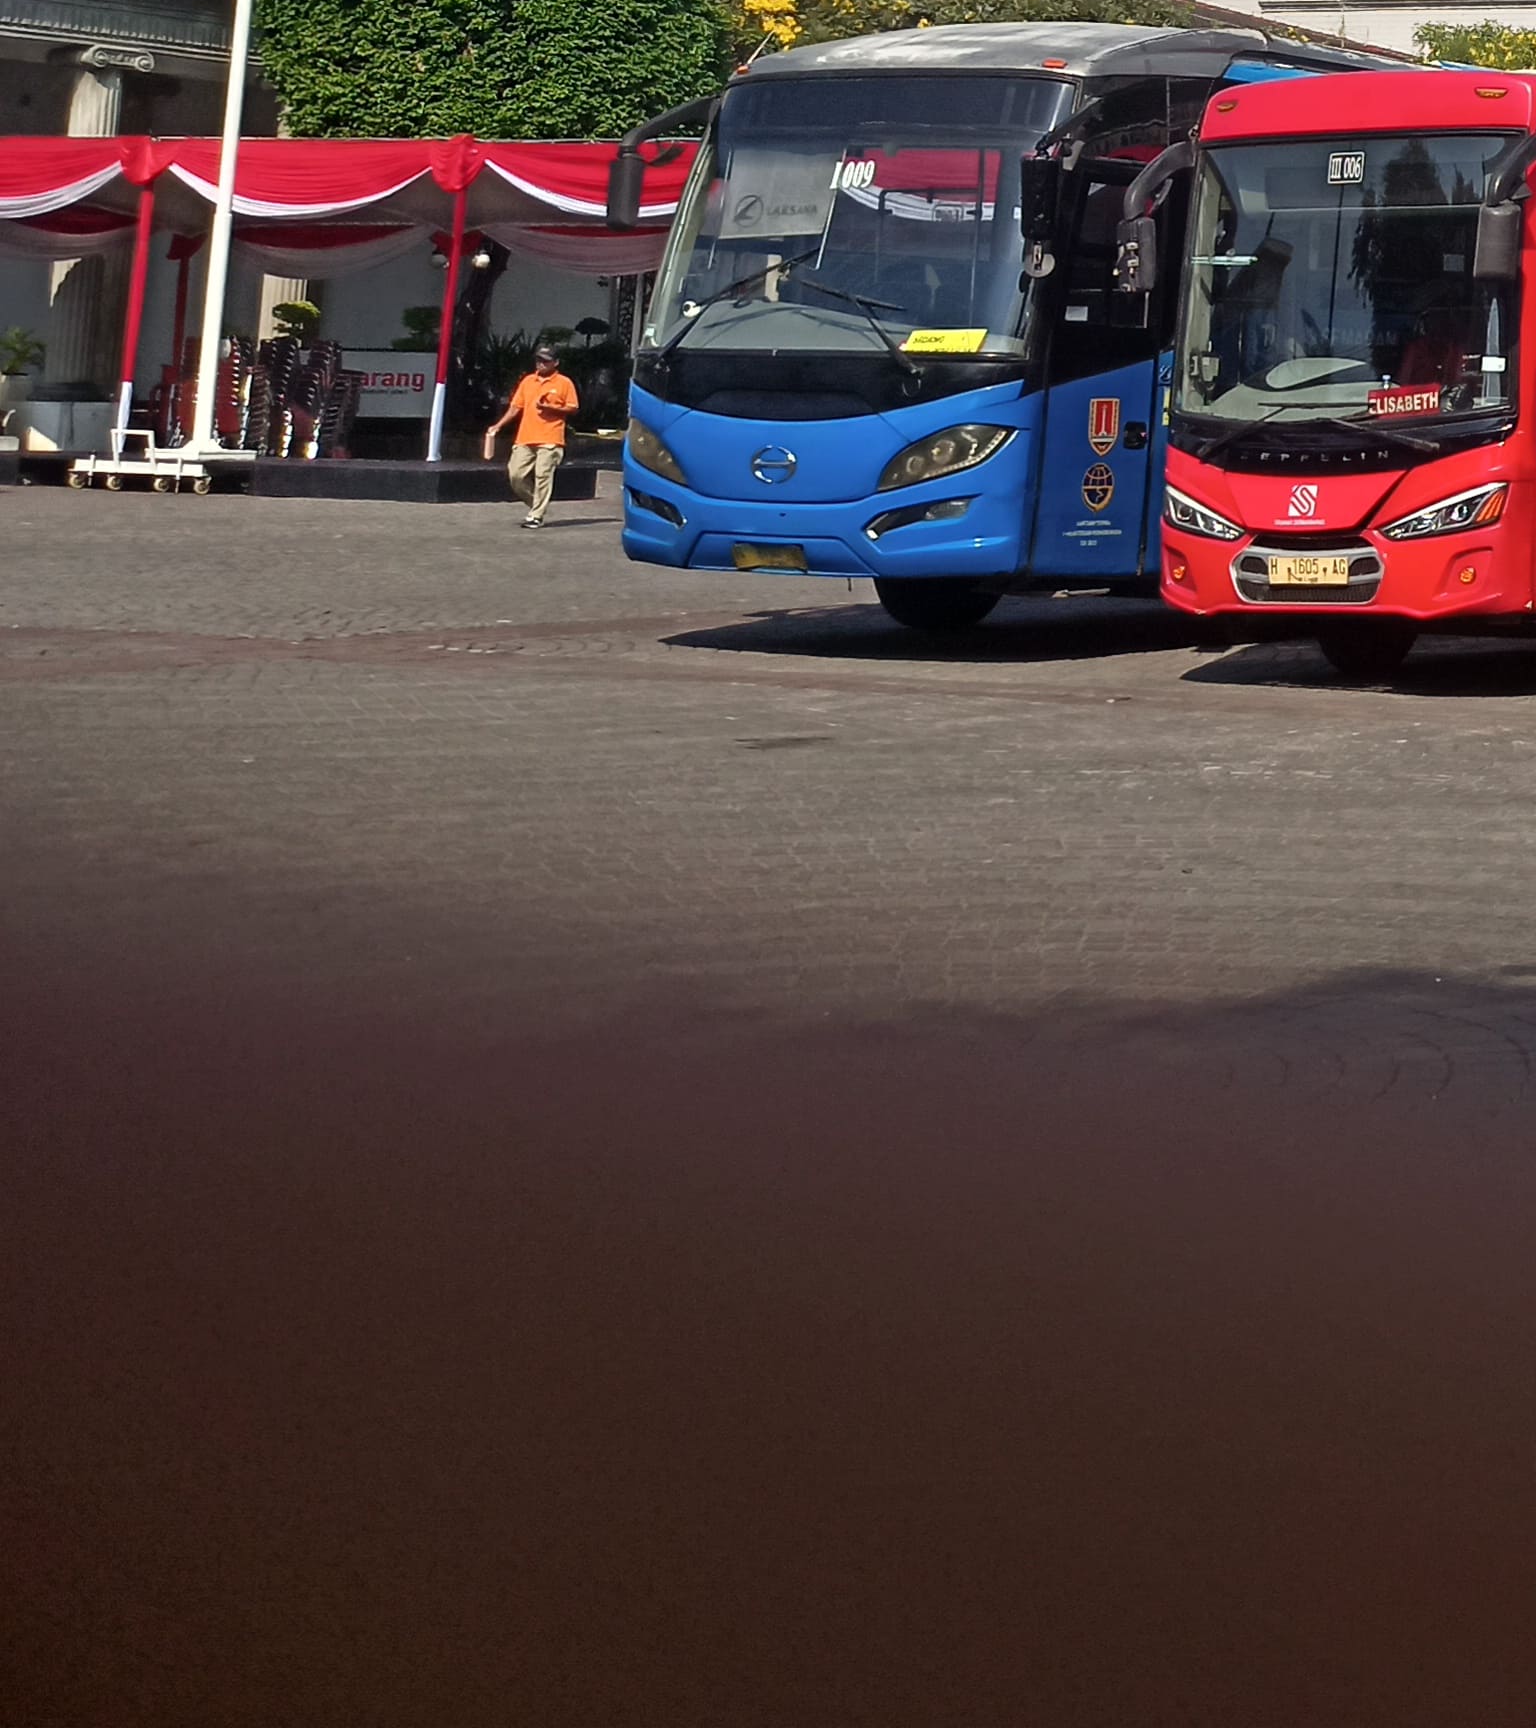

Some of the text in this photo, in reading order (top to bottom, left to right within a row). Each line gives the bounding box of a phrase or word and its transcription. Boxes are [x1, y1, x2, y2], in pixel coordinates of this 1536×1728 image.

[842, 160, 876, 188] 009
[1343, 156, 1362, 179] 006
[1270, 558, 1347, 575] H 1605 AG
